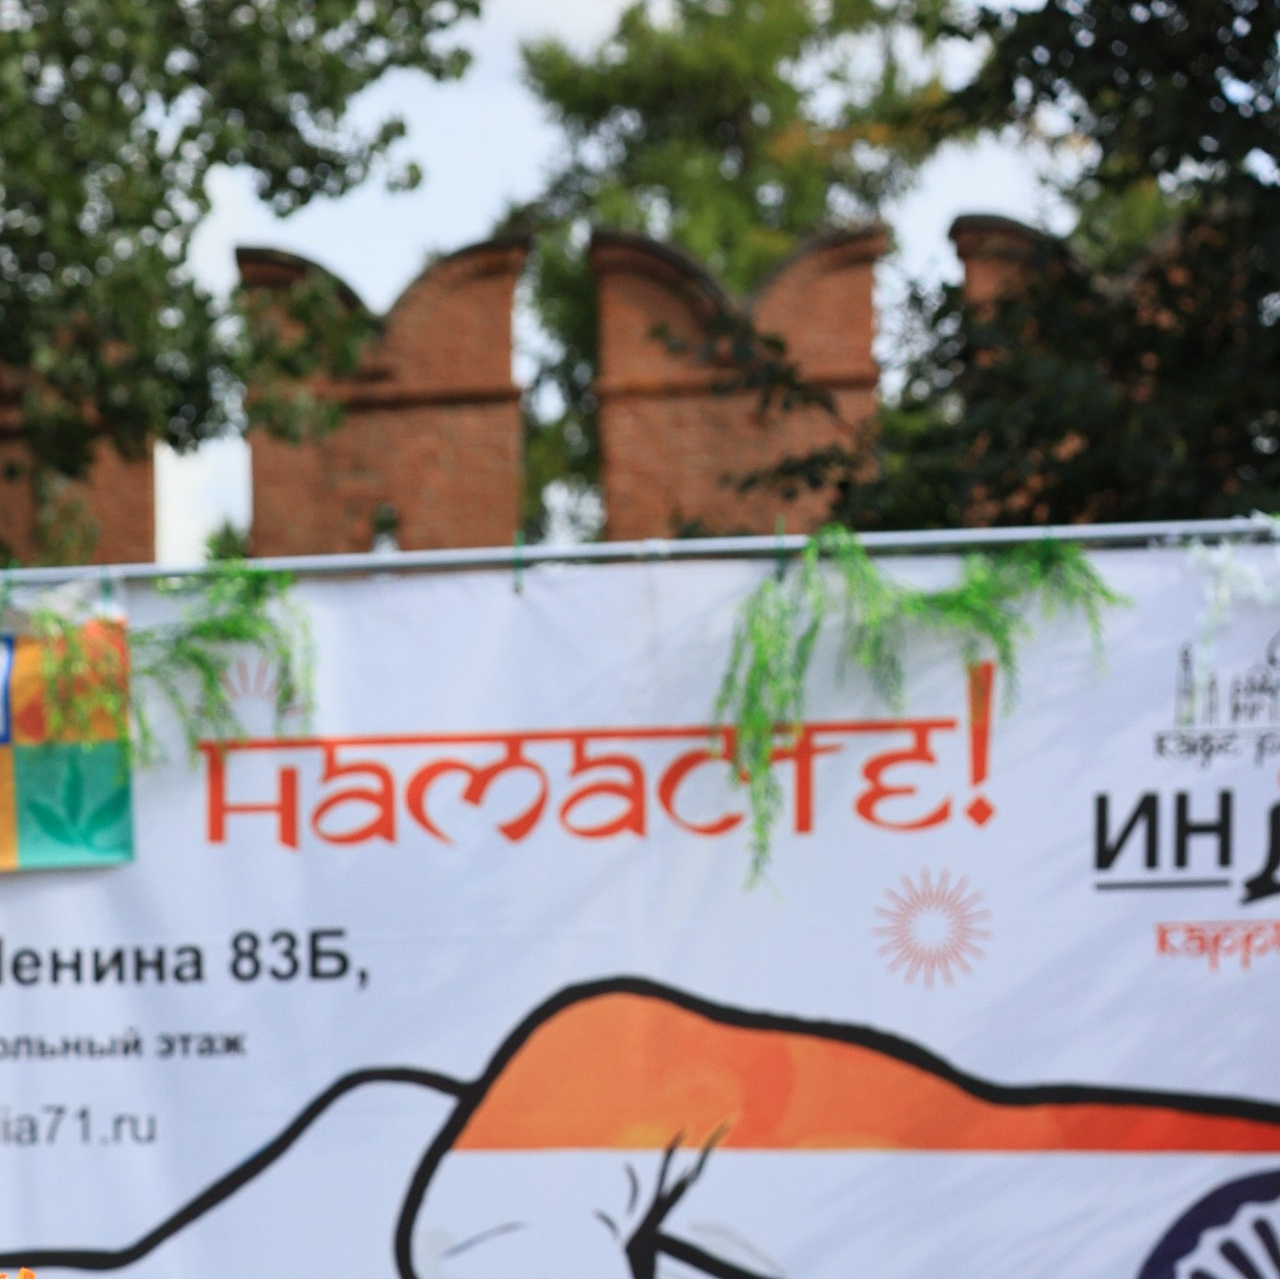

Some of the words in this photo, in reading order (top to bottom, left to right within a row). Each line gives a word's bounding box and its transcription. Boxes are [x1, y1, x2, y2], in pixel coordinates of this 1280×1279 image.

[229, 928, 370, 990] 83Б,
[1156, 920, 1280, 972] карр
[157, 1030, 248, 1058] этаж
